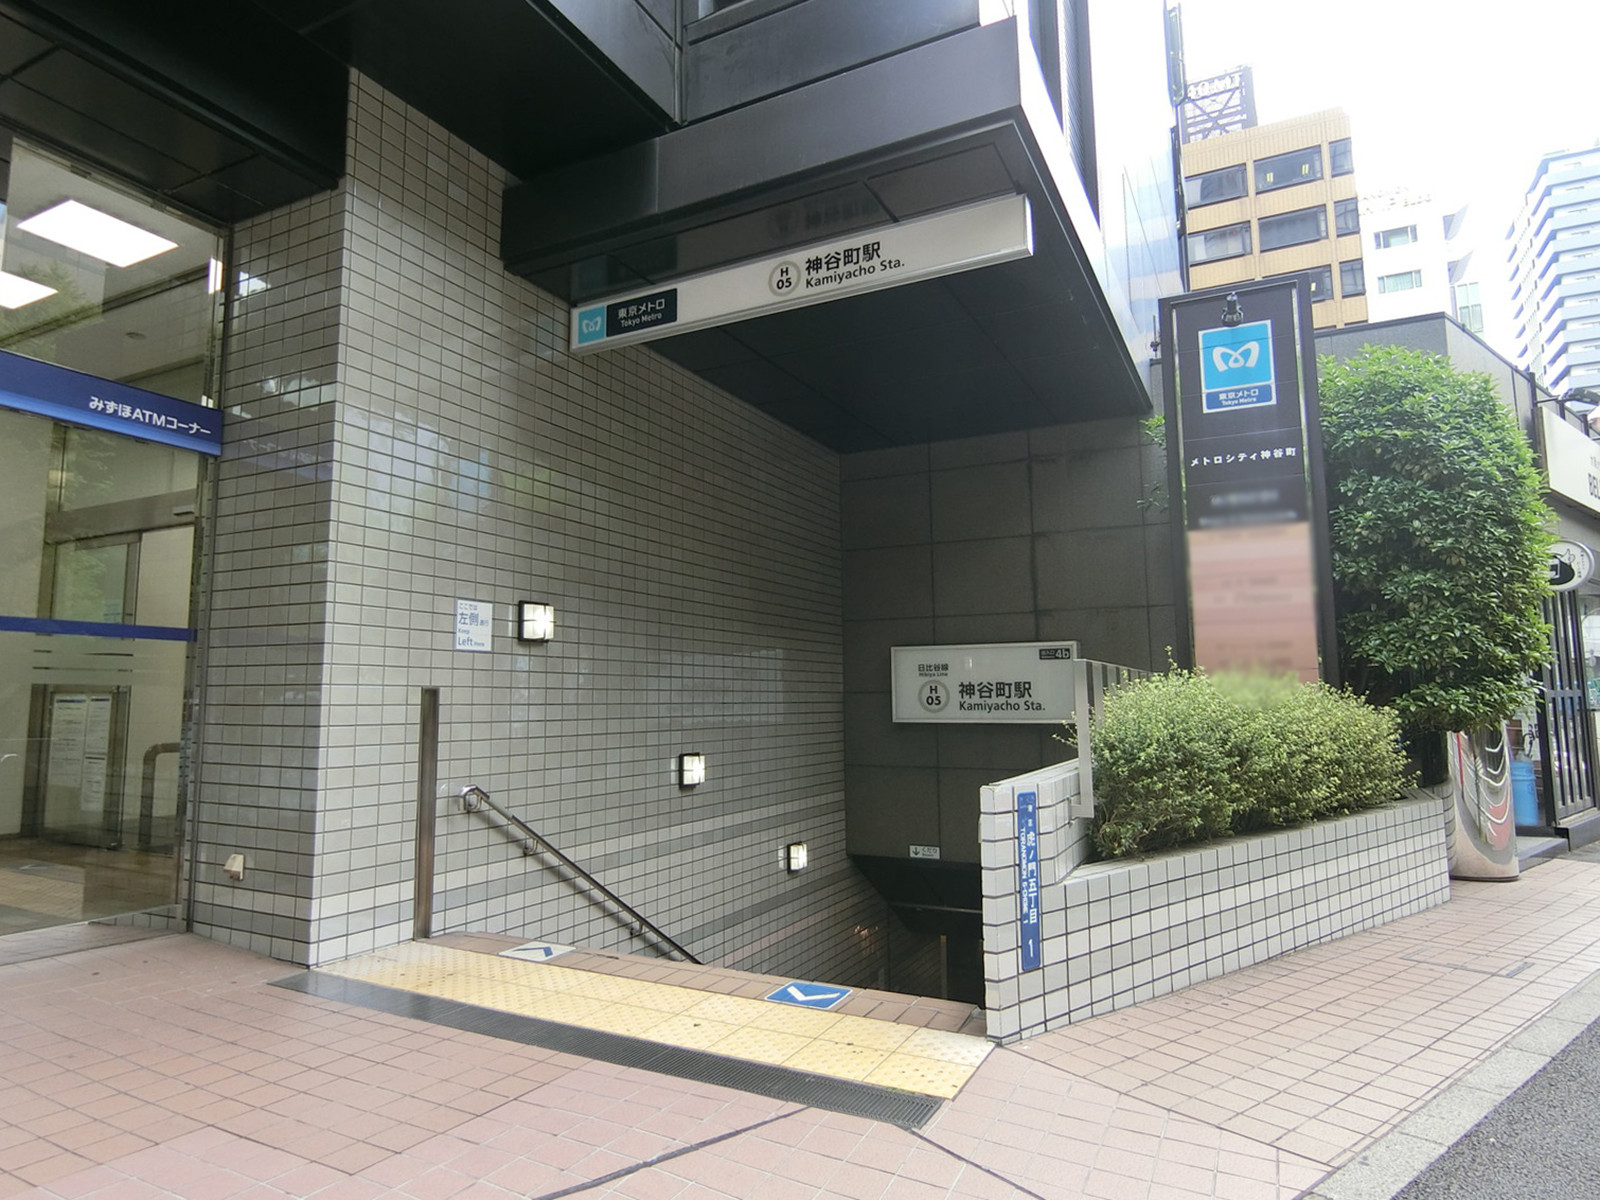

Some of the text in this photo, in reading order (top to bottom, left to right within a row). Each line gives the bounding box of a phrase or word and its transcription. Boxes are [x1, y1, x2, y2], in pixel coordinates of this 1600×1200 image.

[805, 241, 882, 276] 神谷町駅
[780, 267, 789, 278] H
[805, 258, 905, 289] Kamiyacho Sta.
[776, 277, 793, 290] 05
[617, 298, 666, 320] 東京メトロ
[620, 312, 663, 328] Tokyo Metro
[1219, 388, 1259, 401] 東京メトロ
[1221, 396, 1257, 406] Tokyo Metro
[88, 396, 212, 435] みずほATMコーナー
[1190, 447, 1297, 467] メトロシティ神谷町
[457, 636, 473, 647] Left
[1055, 648, 1070, 659] 4b
[918, 663, 949, 673] 日比谷線
[929, 685, 938, 695] H
[958, 681, 1032, 699] 神谷町駅
[926, 695, 942, 706] 05
[959, 700, 1046, 714] Kamiyacho Sta.
[1020, 826, 1028, 879] TORANOMON
[1026, 831, 1038, 924] 虎ノ門五丁目
[1028, 938, 1034, 958] 1
